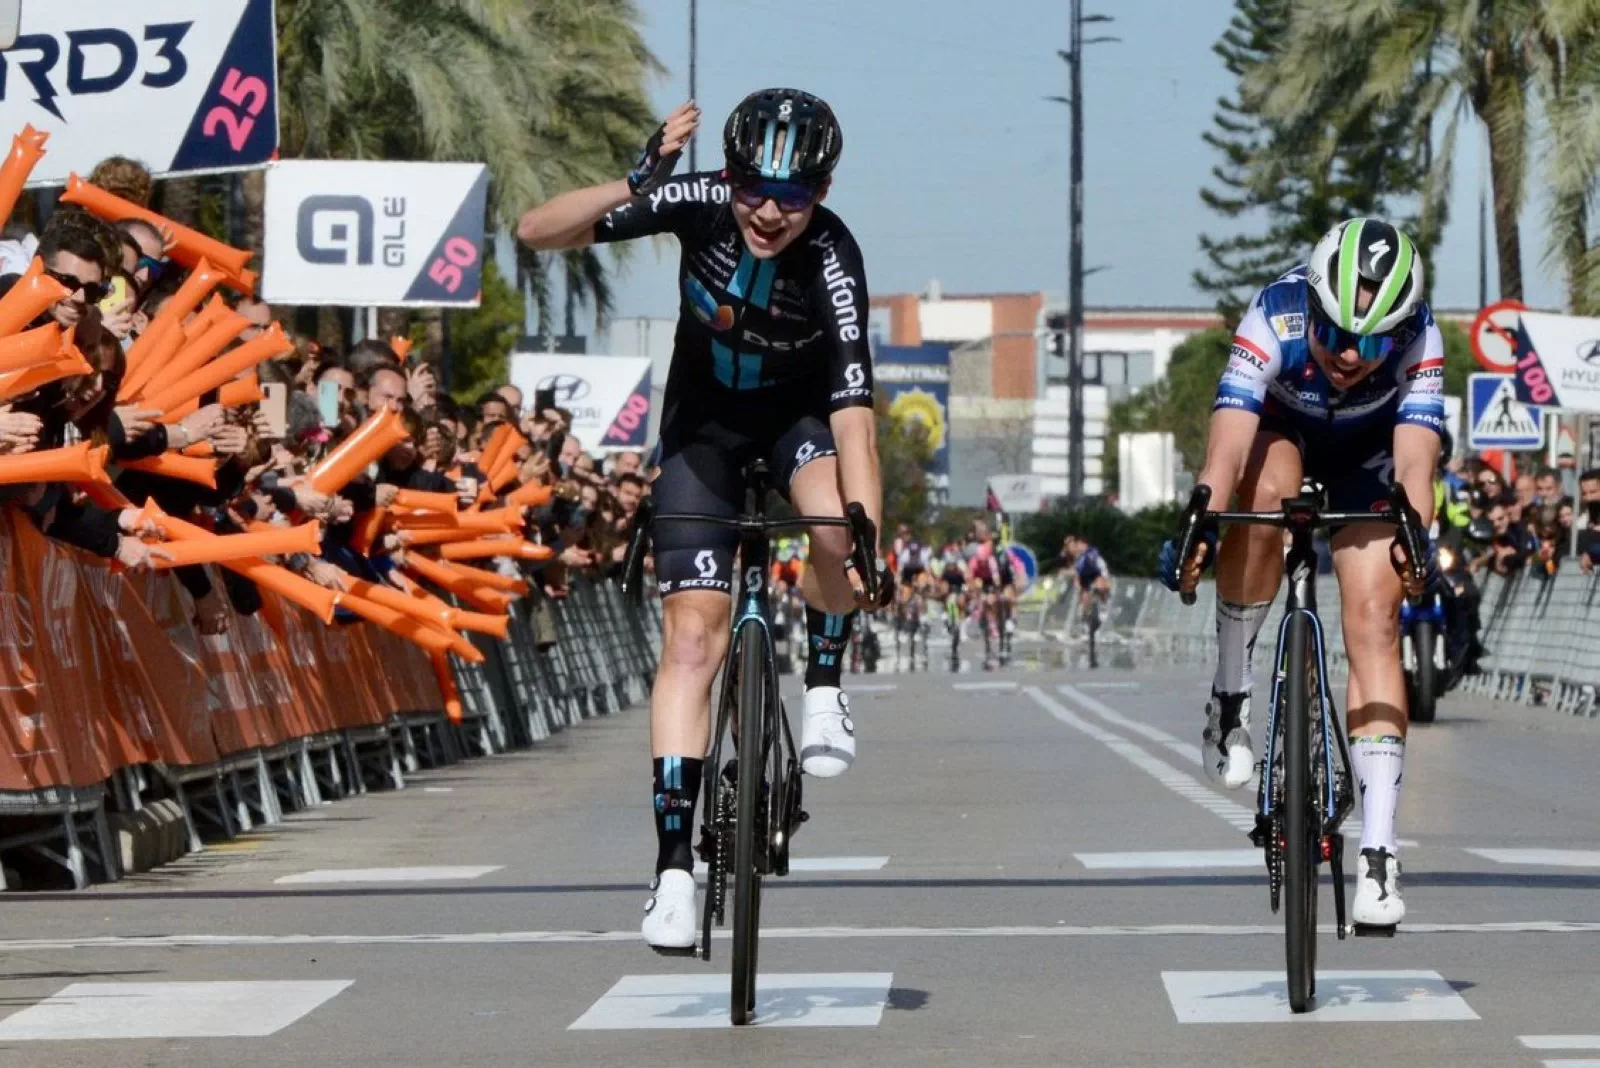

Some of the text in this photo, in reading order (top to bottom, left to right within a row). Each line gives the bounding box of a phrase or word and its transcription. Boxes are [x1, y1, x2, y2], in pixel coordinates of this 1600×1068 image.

[203, 67, 267, 152] 25
[428, 236, 477, 293] 50
[1518, 351, 1552, 403] 100
[606, 392, 649, 442] 100
